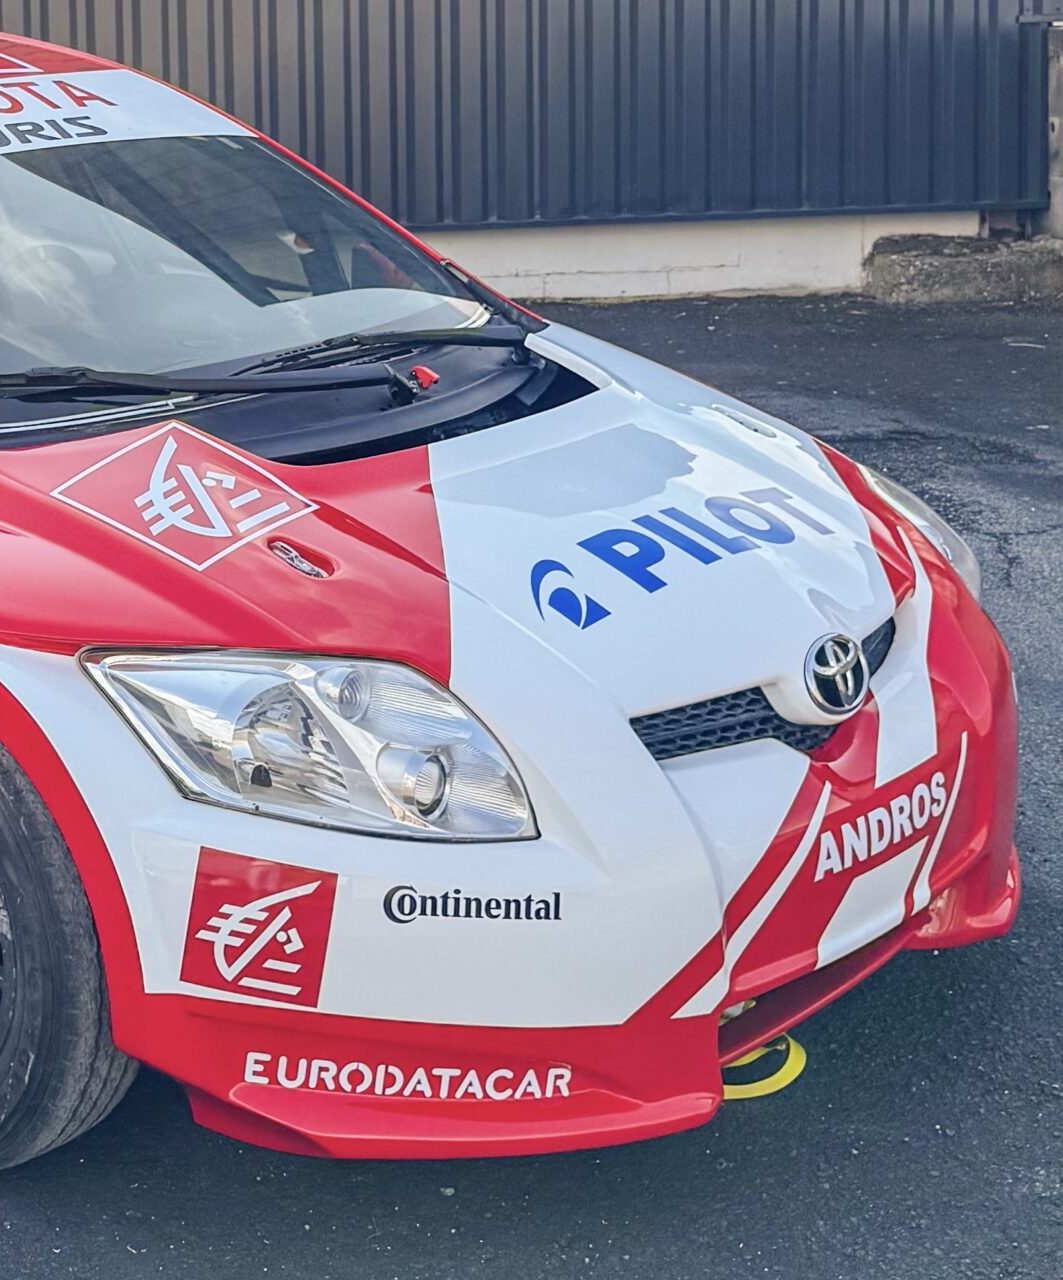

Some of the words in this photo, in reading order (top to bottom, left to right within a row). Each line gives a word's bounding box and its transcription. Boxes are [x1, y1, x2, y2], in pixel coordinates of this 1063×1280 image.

[576, 486, 836, 594] PILOT
[813, 771, 947, 883] ANDROS
[383, 885, 562, 924] Continental
[244, 1051, 572, 1100] EURODATACAR
